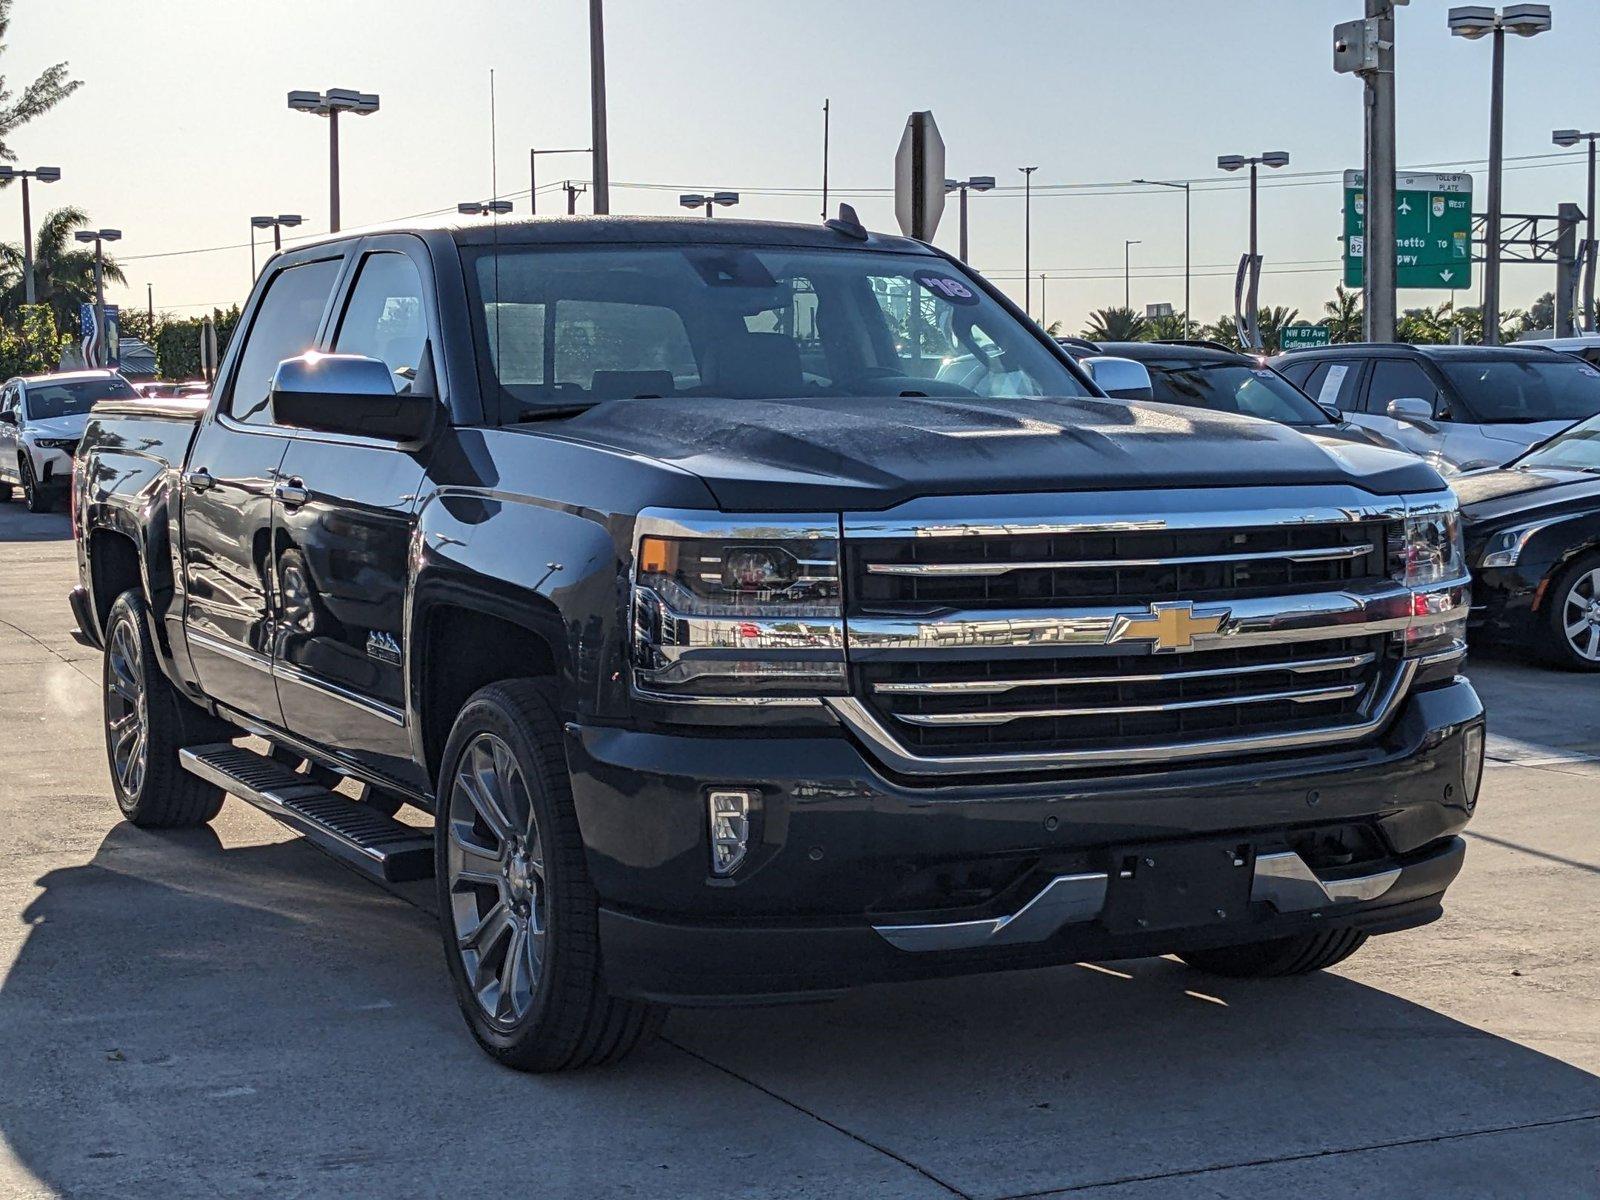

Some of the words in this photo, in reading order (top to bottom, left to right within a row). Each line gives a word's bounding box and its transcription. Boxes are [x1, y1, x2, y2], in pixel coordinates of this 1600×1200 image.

[1439, 184, 1459, 192] PLATE
[1448, 200, 1465, 208] WEST
[1437, 239, 1448, 248] TO
[1397, 255, 1417, 266] pwy
[1286, 329, 1298, 338] NW
[1300, 329, 1311, 338] 87
[1312, 329, 1325, 337] Ave
